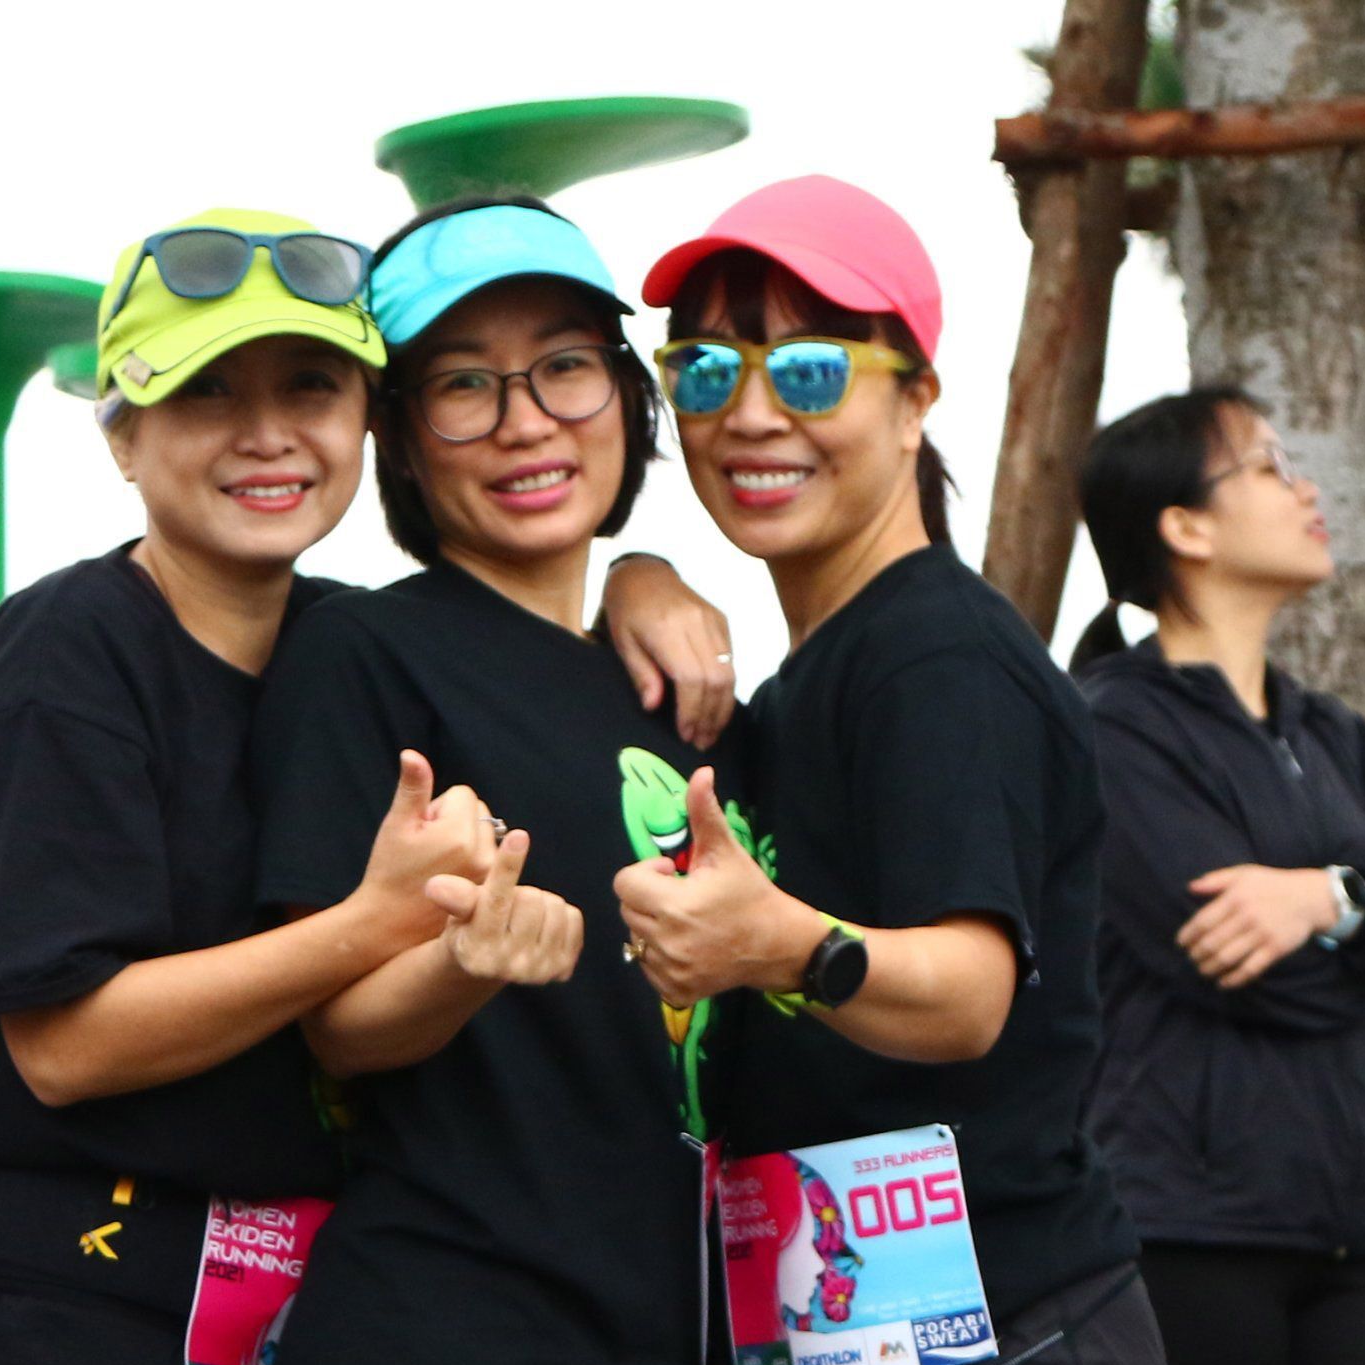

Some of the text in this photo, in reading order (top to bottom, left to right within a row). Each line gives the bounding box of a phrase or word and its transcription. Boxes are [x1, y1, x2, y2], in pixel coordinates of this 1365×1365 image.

[853, 1143, 955, 1174] 333 RUNNERS
[848, 1169, 964, 1239] 005
[211, 1218, 296, 1253] EKIDEN
[207, 1240, 304, 1278] RUNNING
[914, 1312, 986, 1337] POCARI
[917, 1326, 981, 1350] SWEAT
